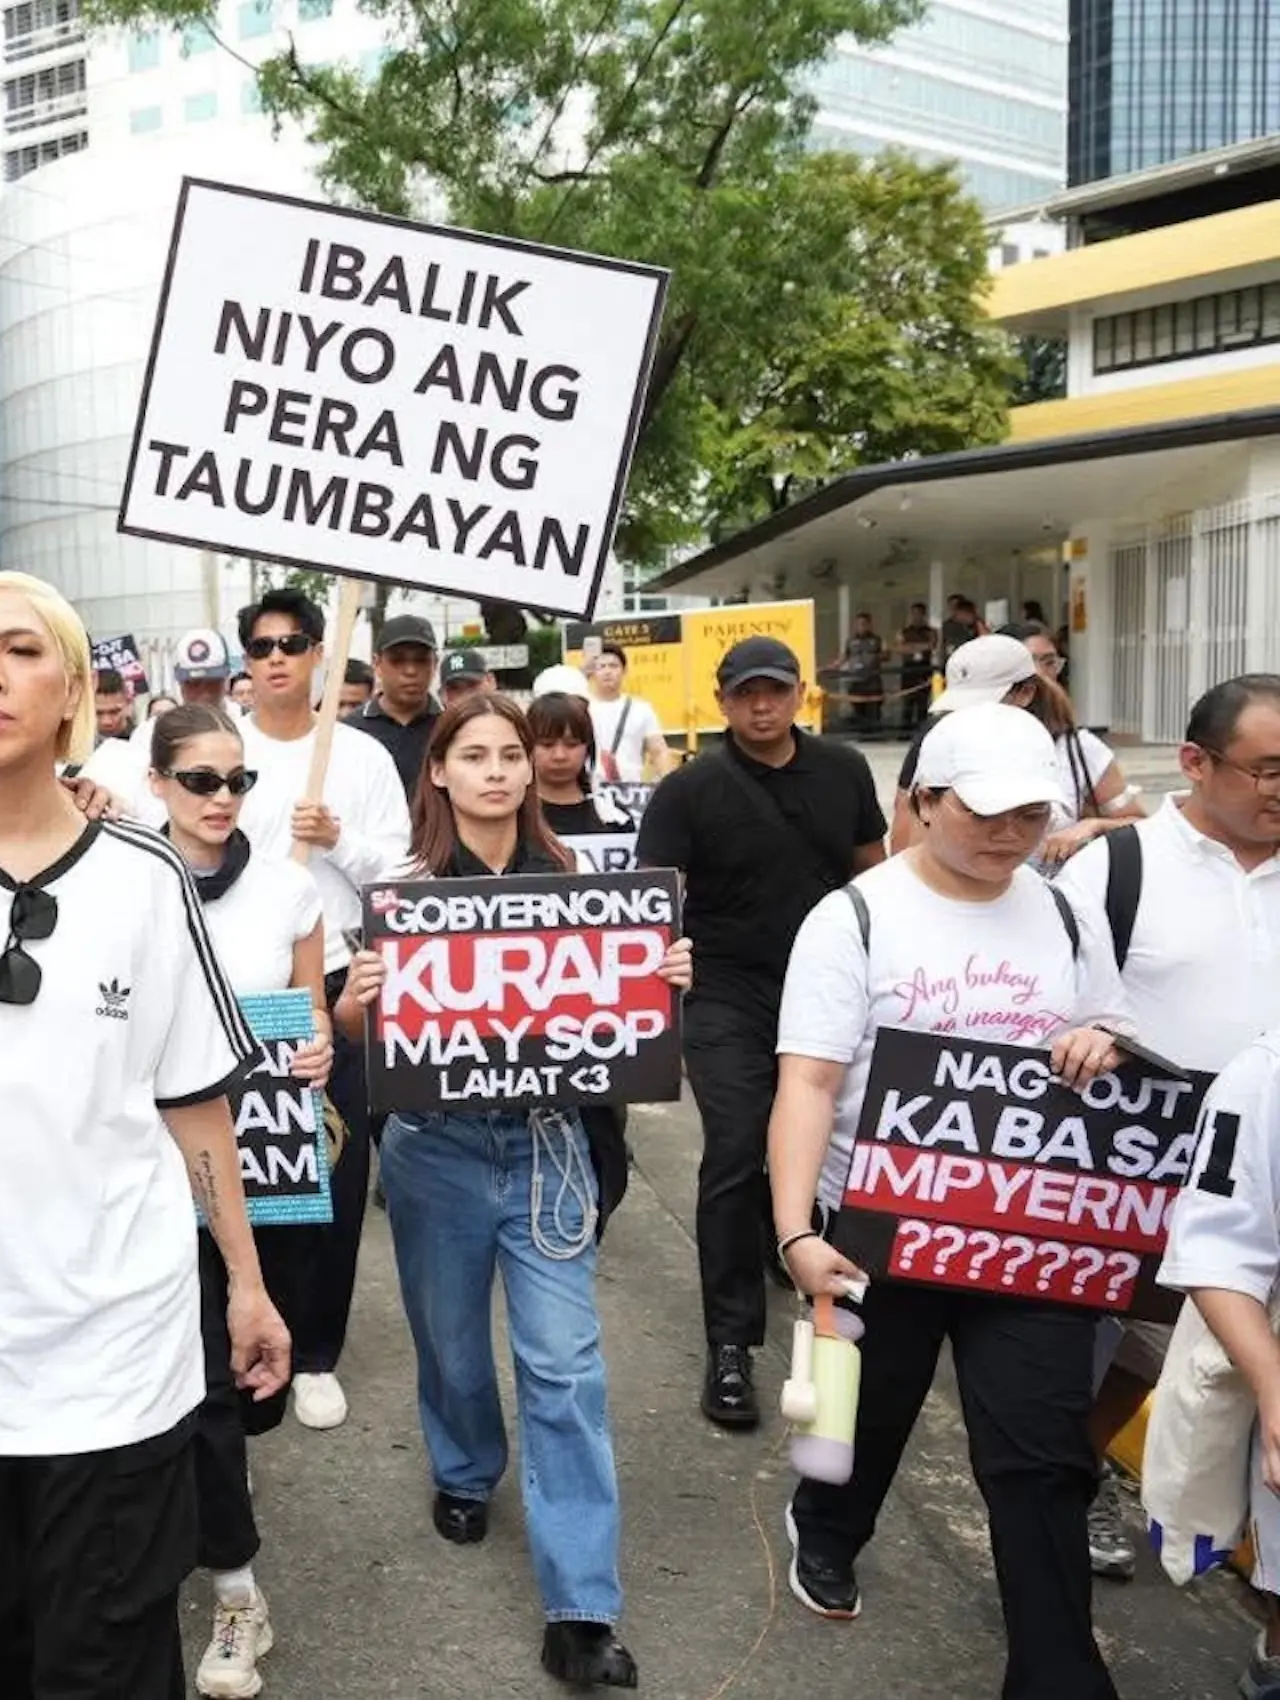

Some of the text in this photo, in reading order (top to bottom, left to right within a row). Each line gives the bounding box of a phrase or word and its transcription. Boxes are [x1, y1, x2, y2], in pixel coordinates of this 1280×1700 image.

[298, 238, 532, 336] IBALIK
[213, 299, 581, 422] NIYO ANG
[223, 379, 542, 491] PERA NG
[148, 440, 591, 577] TAUMBAYAN
[385, 887, 672, 934] GOBYERNONG
[380, 930, 666, 1016] KURAP
[893, 966, 959, 1023] Ang
[384, 1010, 666, 1069] MAY SOP
[440, 1066, 563, 1100] LAHAT
[876, 1090, 1194, 1180] KA BA SA
[846, 1145, 1176, 1237] IMPYERN
[897, 1220, 1141, 1302] ???????
